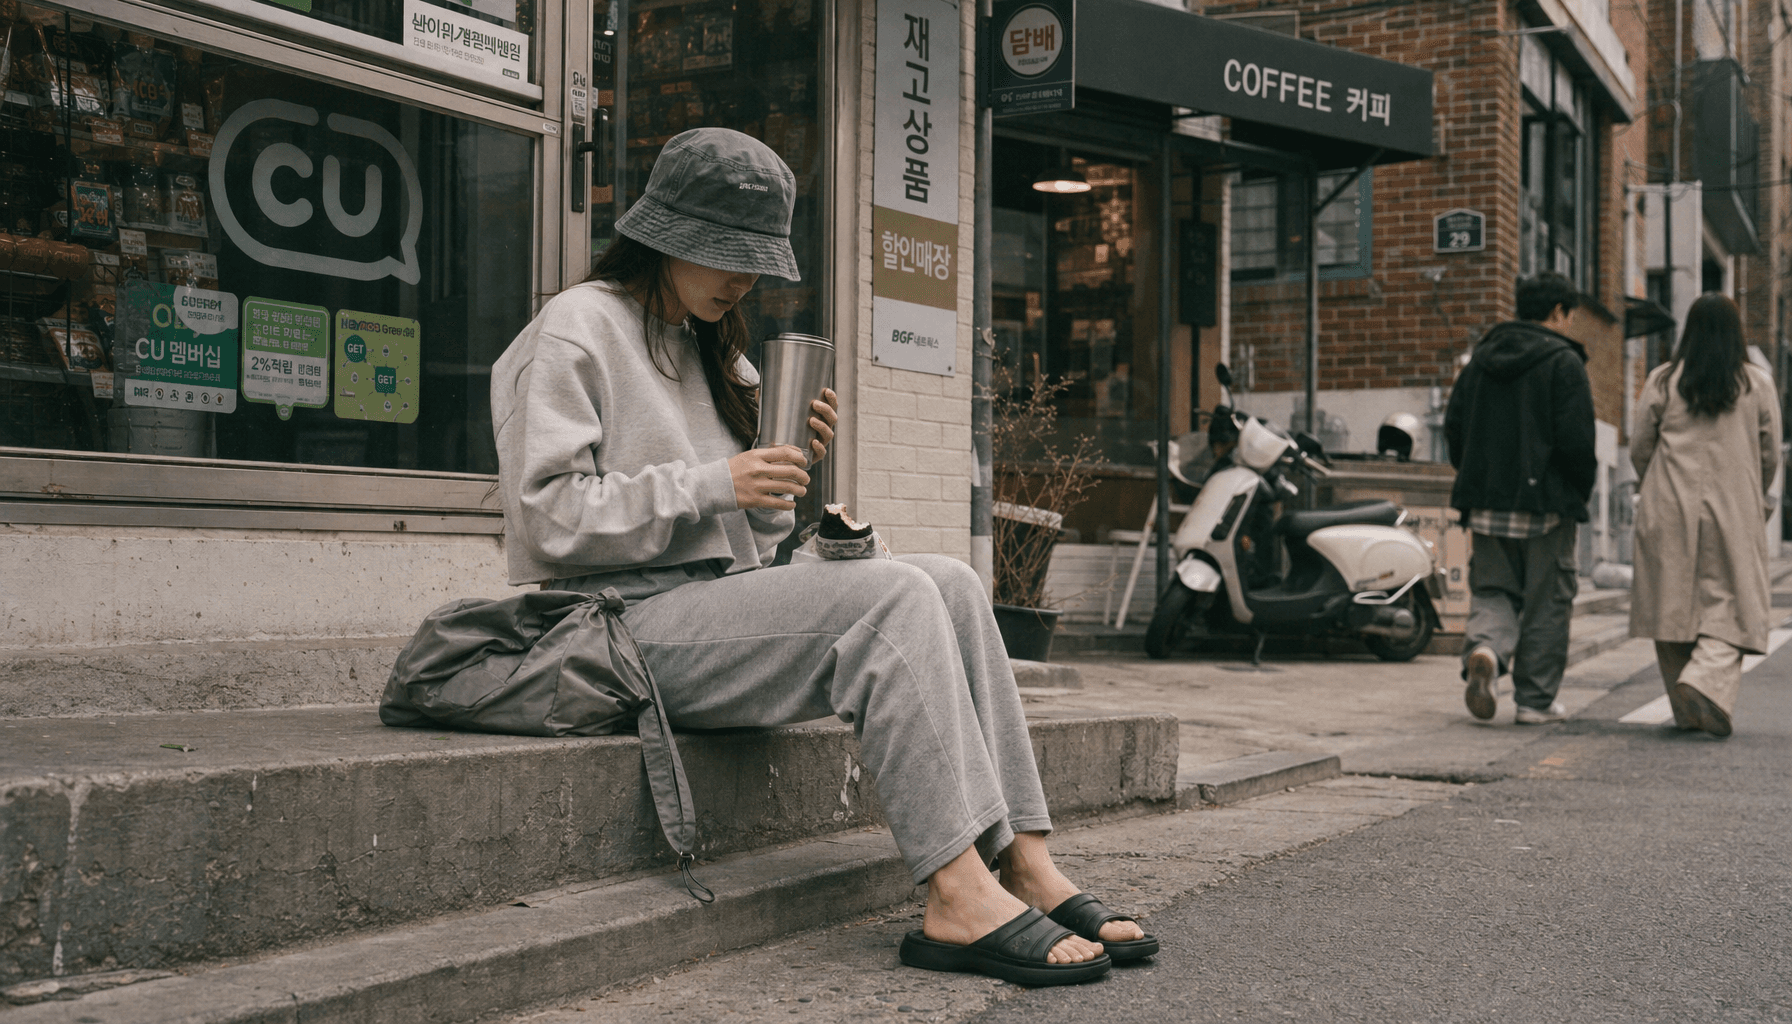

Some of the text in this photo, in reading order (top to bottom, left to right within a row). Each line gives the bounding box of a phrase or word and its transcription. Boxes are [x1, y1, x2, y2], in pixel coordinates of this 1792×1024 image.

[1010, 24, 1055, 56] 담배
[902, 13, 932, 204] 재고상품
[1224, 58, 1391, 127] COFFEE 커피
[251, 142, 383, 238] CU
[881, 230, 952, 281] 할인매장
[1448, 231, 1471, 248] 29
[135, 337, 166, 361] CU
[169, 340, 222, 370] 멤버십
[347, 343, 365, 355] GET
[377, 374, 395, 386] GET
